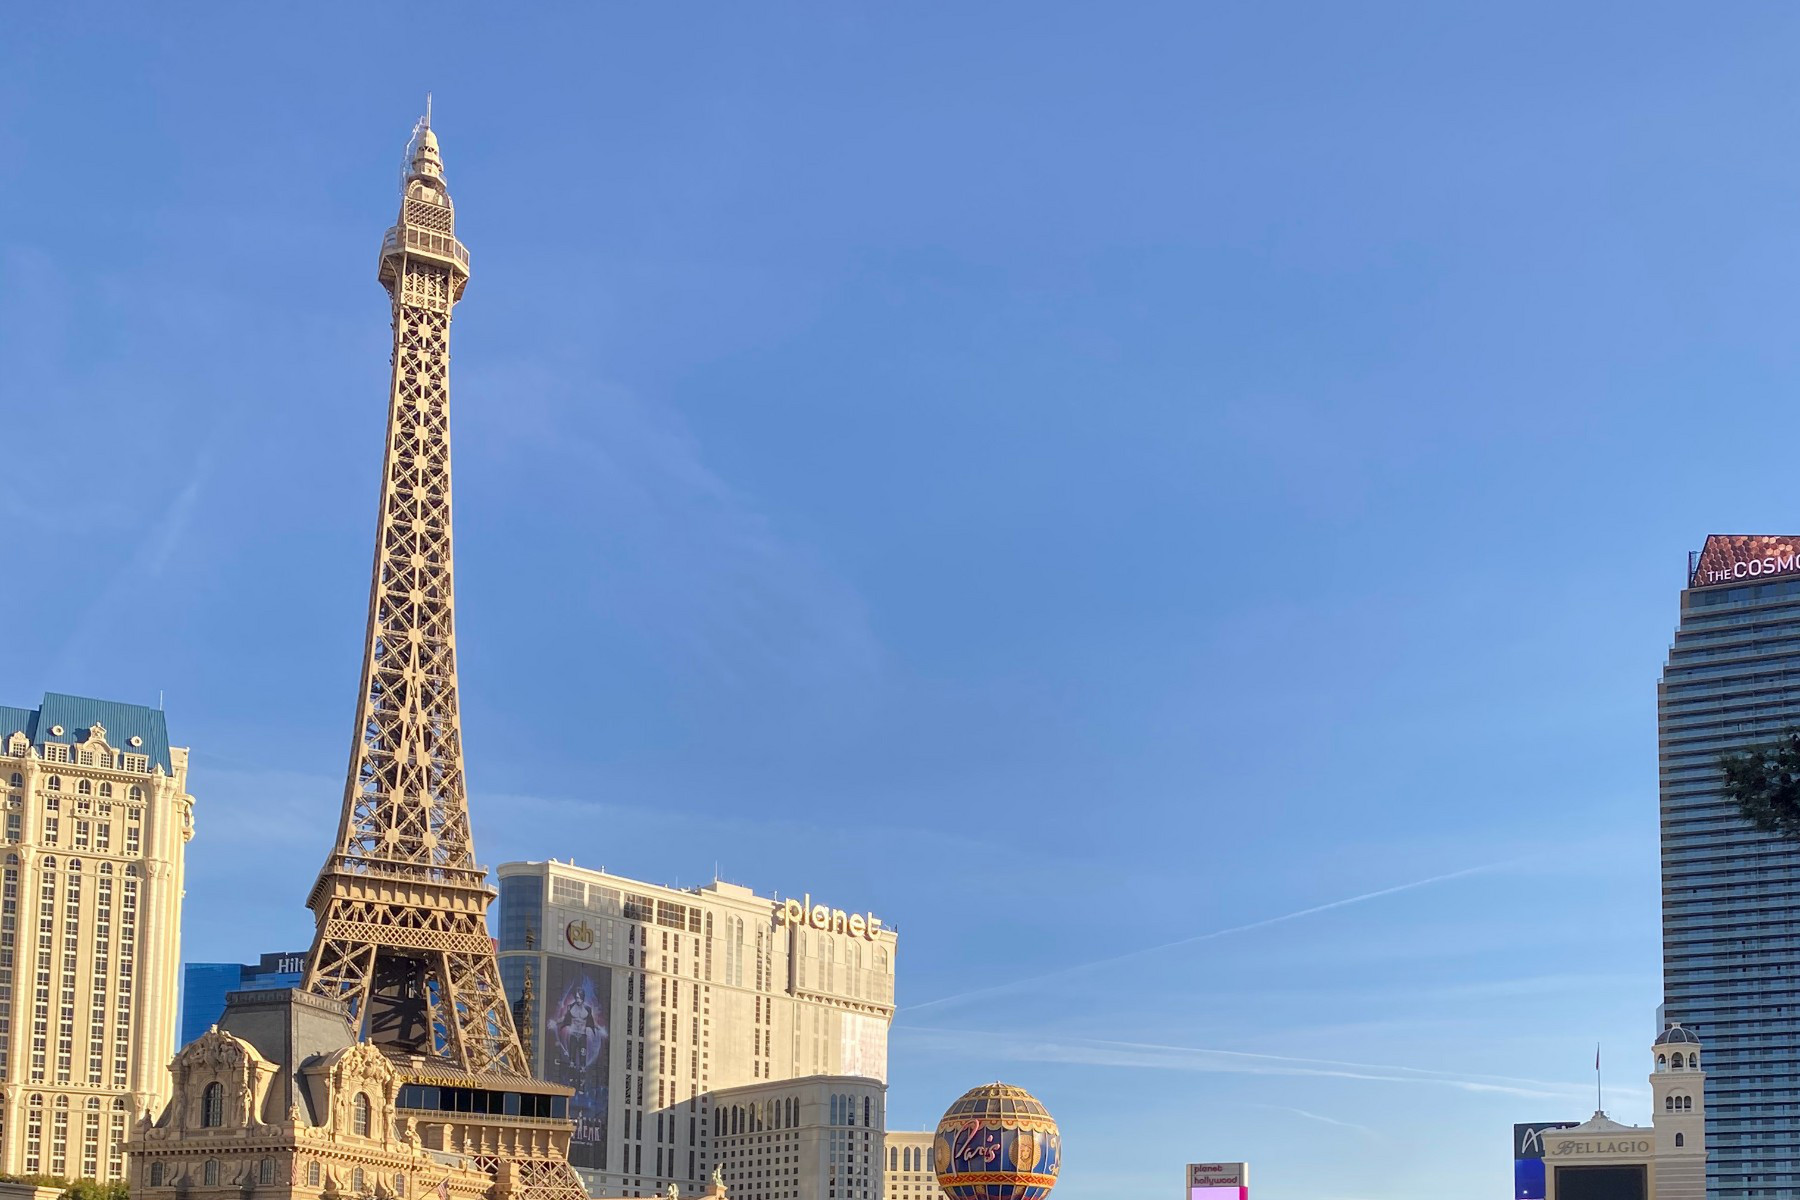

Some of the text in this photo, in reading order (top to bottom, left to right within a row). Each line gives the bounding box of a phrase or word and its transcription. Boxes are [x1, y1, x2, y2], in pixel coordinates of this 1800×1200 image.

[1707, 569, 1732, 582] THE
[785, 893, 882, 940] planet
[278, 958, 305, 973] Hilt
[418, 1076, 478, 1088] RESTAURANT
[952, 1119, 1000, 1178] Paris
[1552, 1140, 1649, 1155] BELLAGIO
[1194, 1165, 1223, 1174] planet
[1194, 1176, 1238, 1186] hollywood
